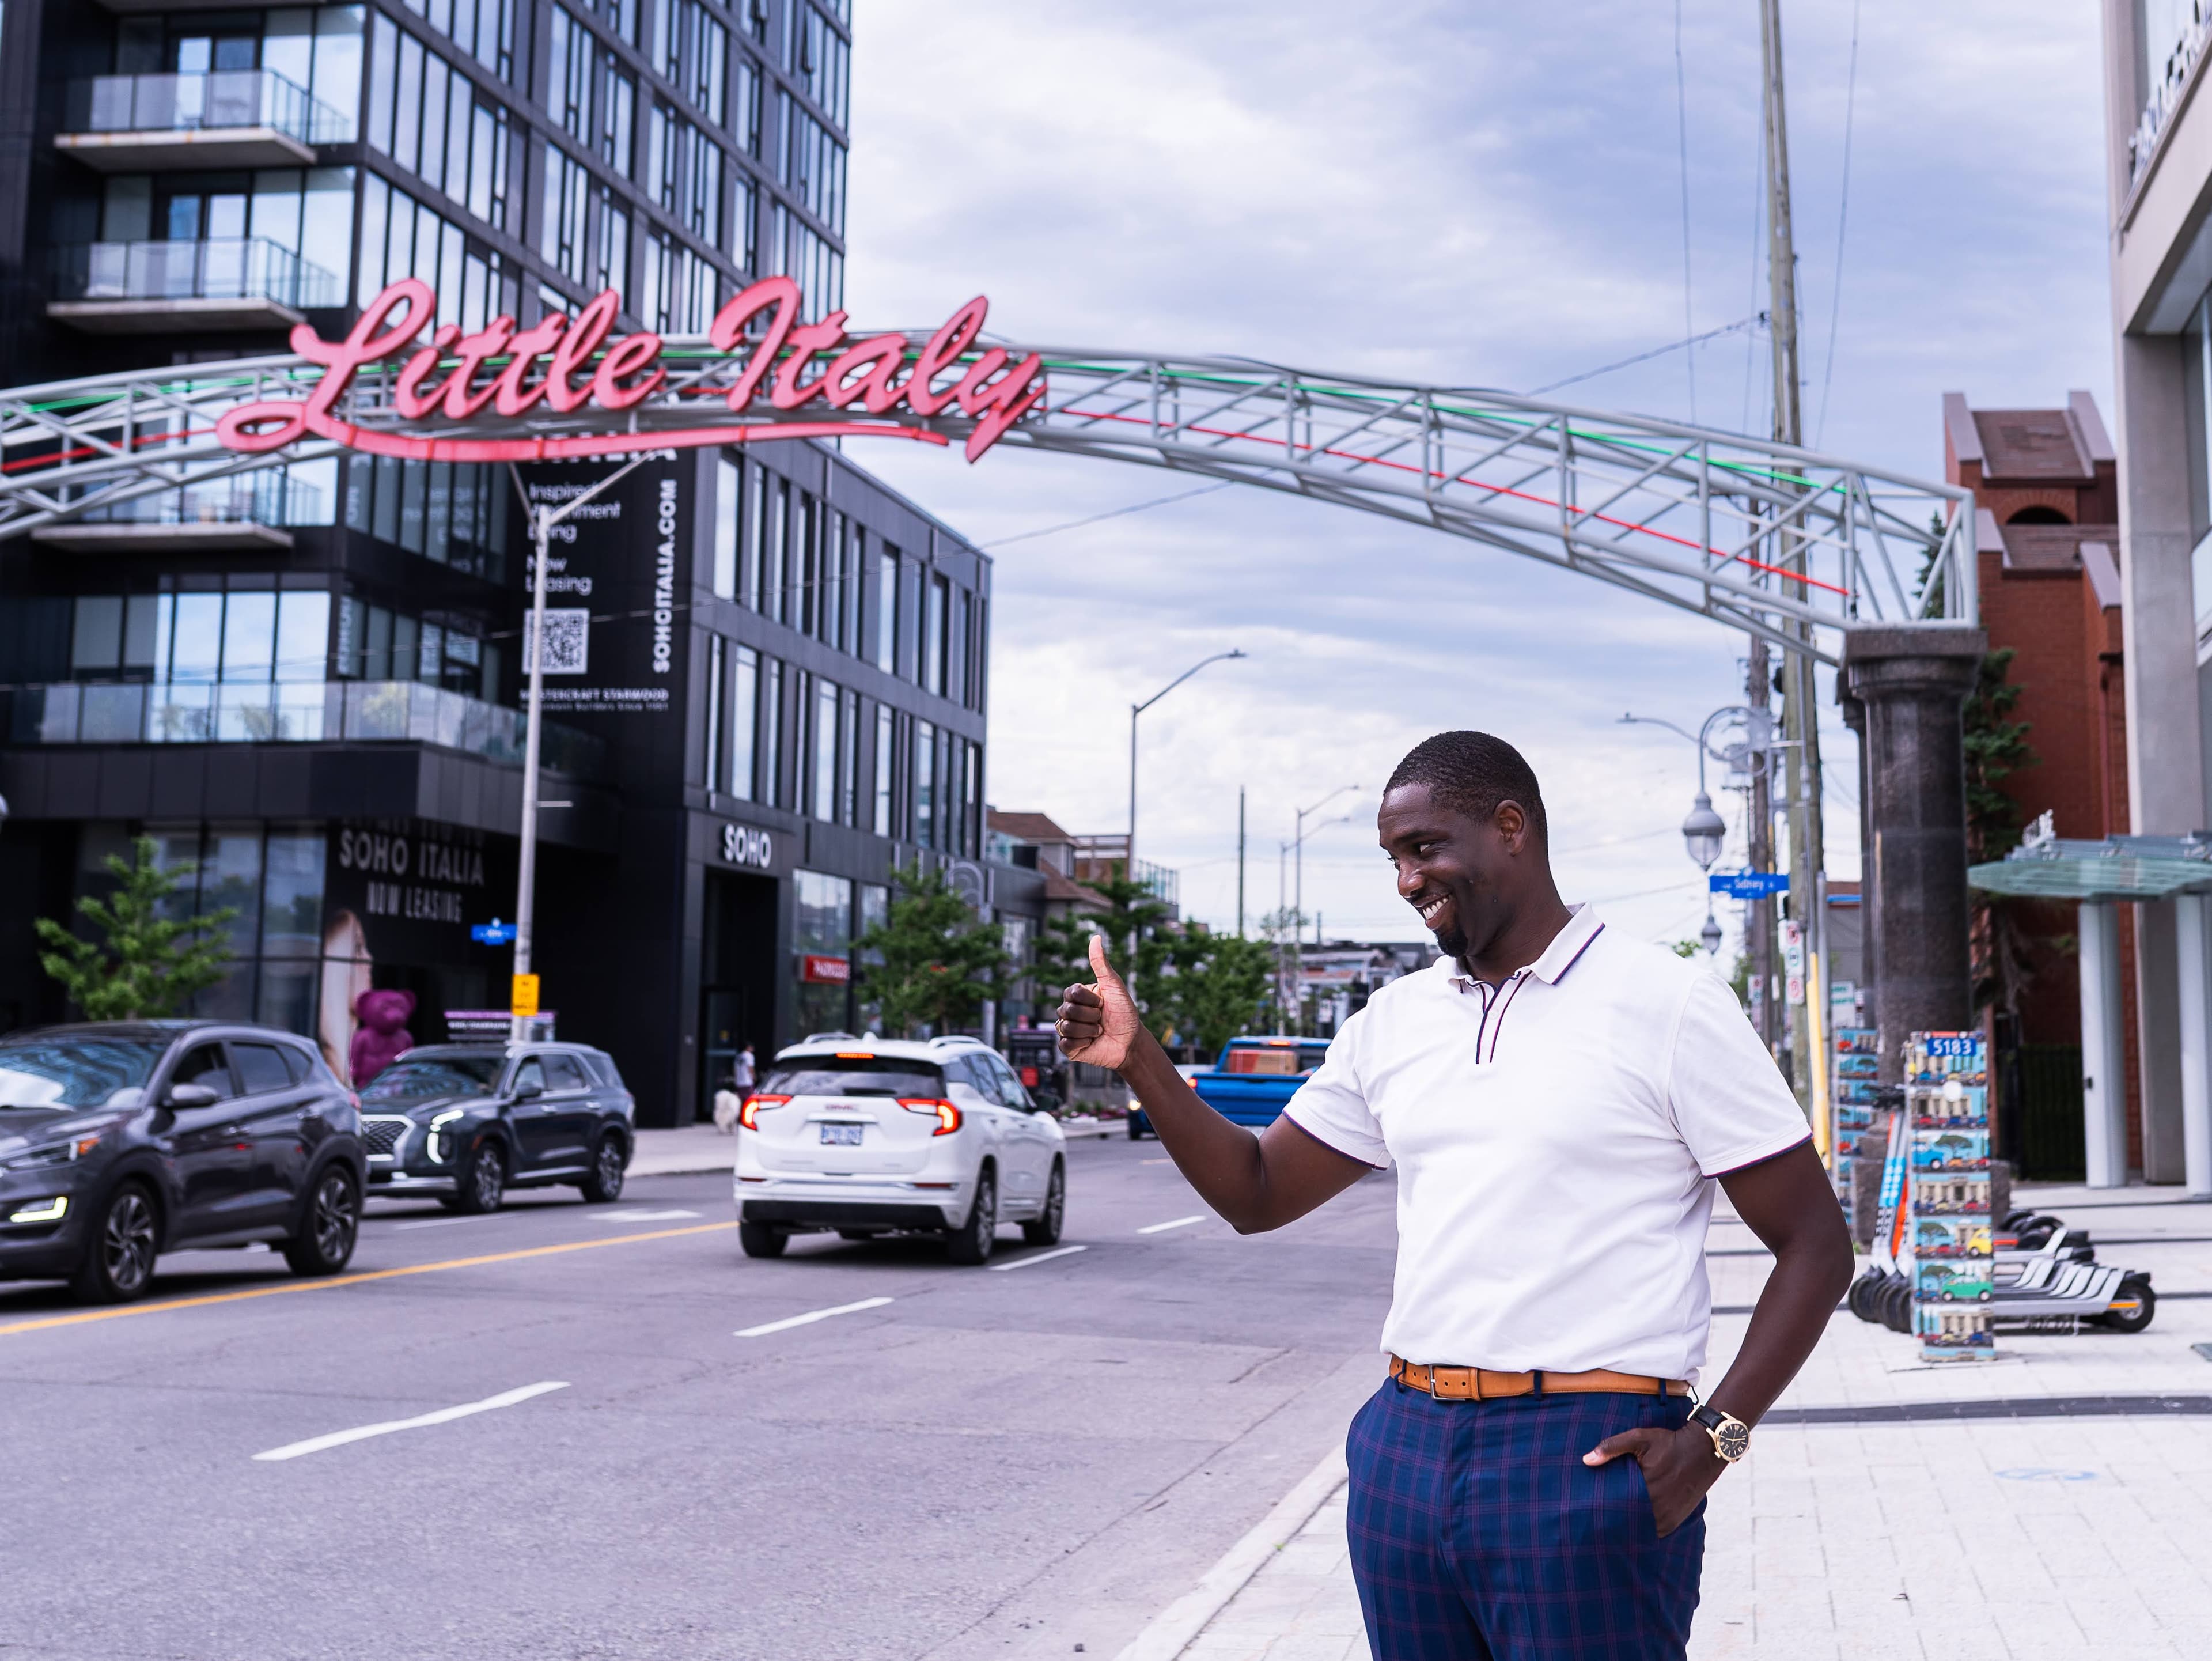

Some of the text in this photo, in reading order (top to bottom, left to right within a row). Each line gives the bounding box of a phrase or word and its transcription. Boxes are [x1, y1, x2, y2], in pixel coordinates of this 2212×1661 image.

[217, 274, 1047, 464] Little Italy
[527, 522, 577, 544] Ling
[525, 574, 593, 596] Lasing
[652, 479, 677, 673] SOHOITALIA.COM
[339, 830, 484, 886] SOHO ITALIA
[724, 823, 772, 868] SOHO
[367, 881, 463, 922] NOW LEASING
[1933, 1038, 1972, 1055] 5183
